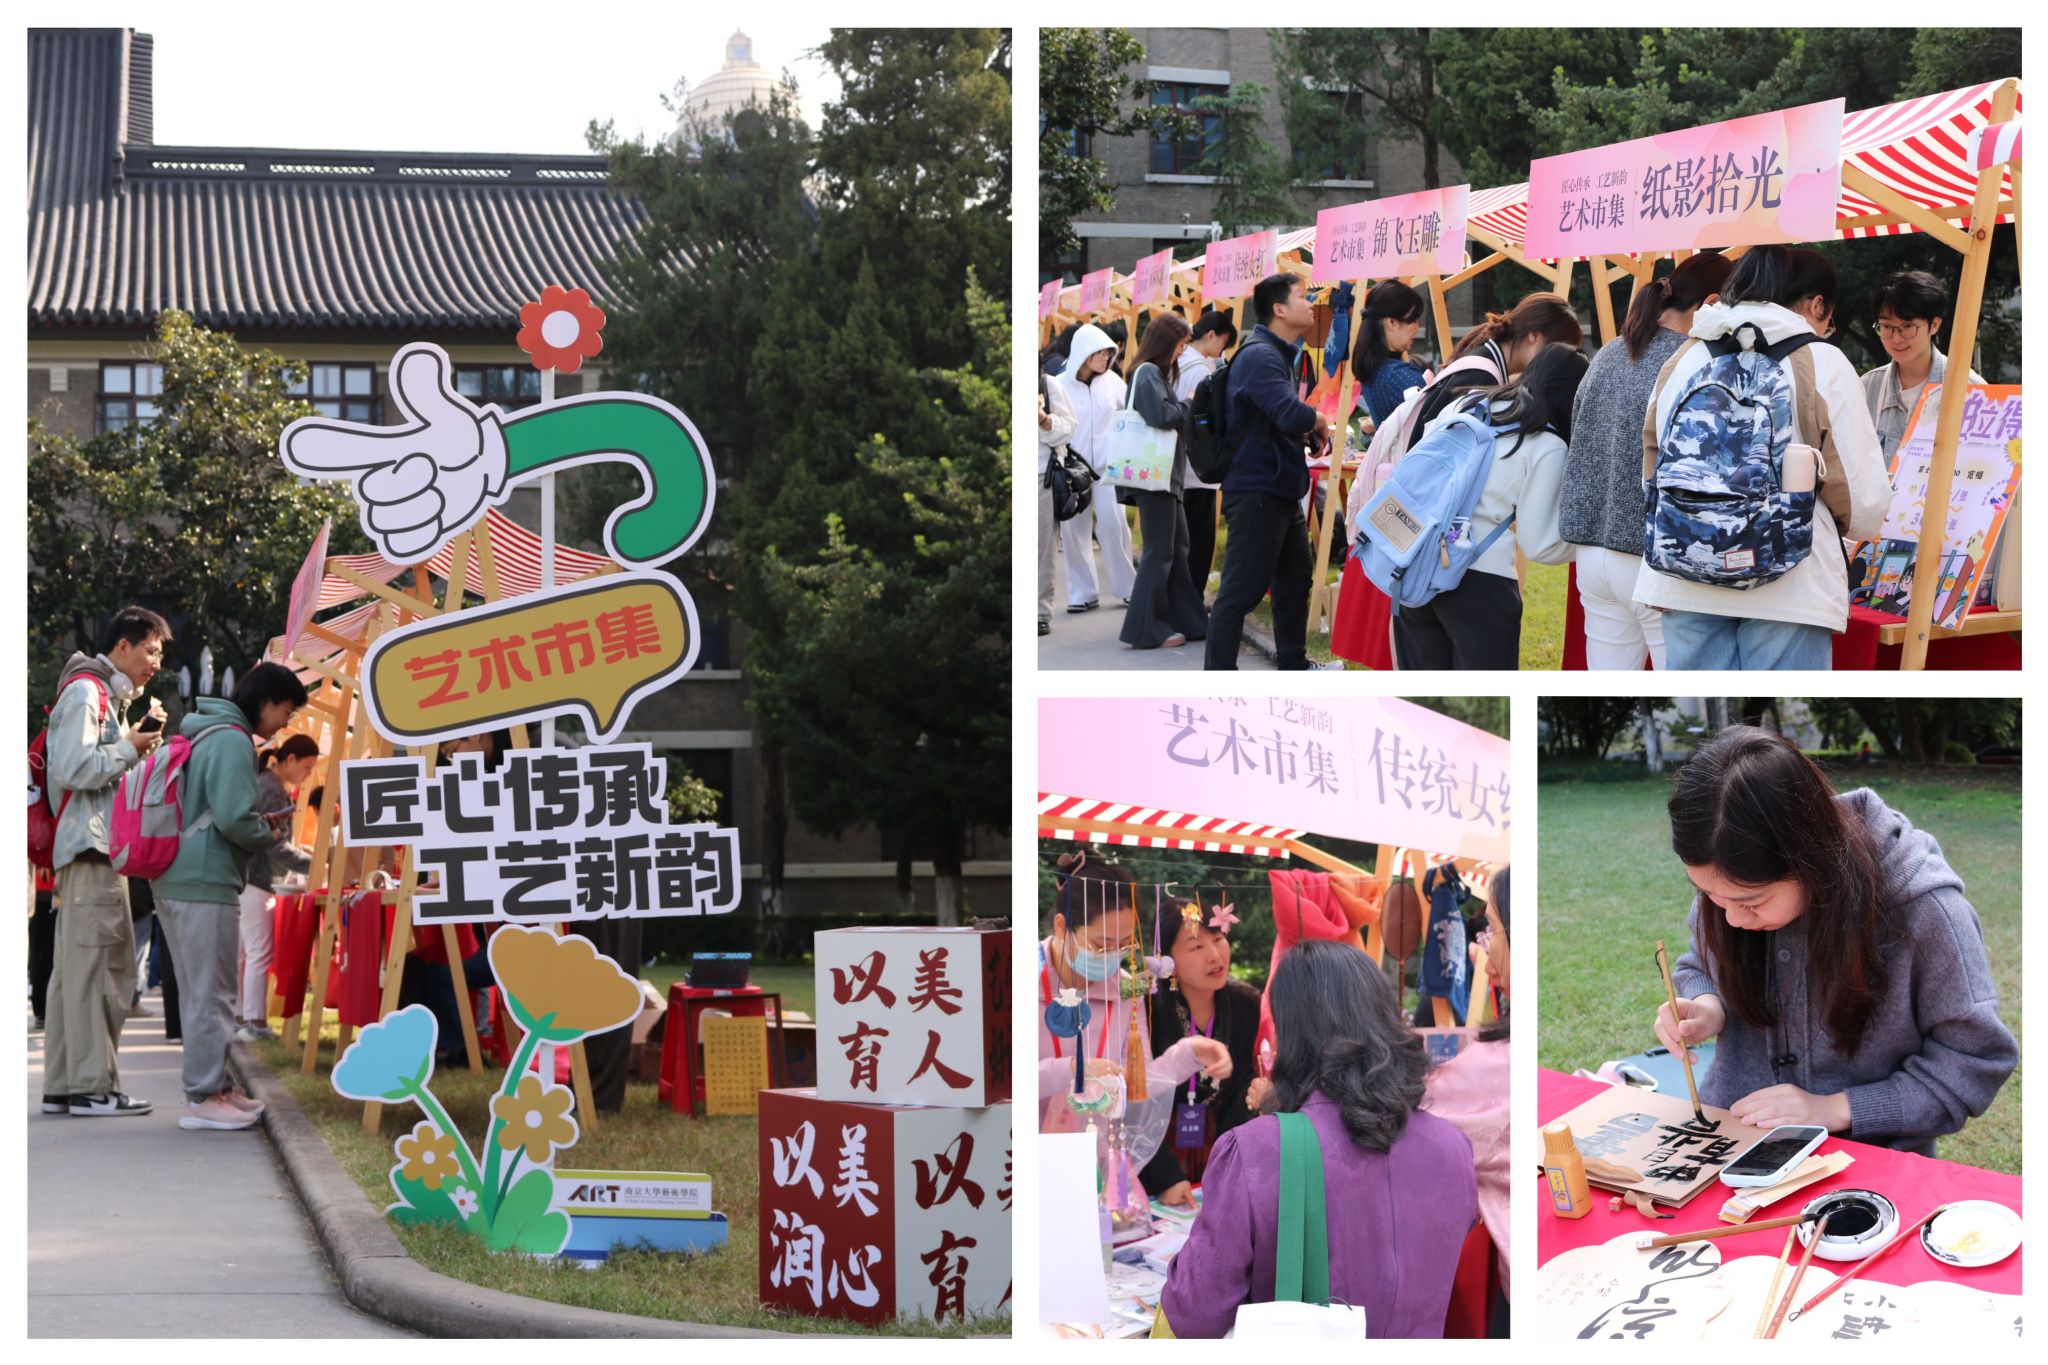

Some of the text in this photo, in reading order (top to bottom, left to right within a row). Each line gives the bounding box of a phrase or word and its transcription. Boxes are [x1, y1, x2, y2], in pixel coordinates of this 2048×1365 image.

[1559, 193, 1625, 233] 艺术市集
[1561, 169, 1628, 194] 匠心传承 工艺新韵
[1640, 146, 1783, 221] 纸影拾光
[1330, 237, 1365, 263] 艺术市集
[1373, 211, 1441, 258] 锦飞玉雕
[404, 603, 662, 709] 艺术市集
[1159, 703, 1340, 795] 艺术市集
[347, 750, 662, 839] 匠心传承
[420, 831, 732, 918] 工艺新韵
[829, 947, 963, 1015] 以美
[838, 1021, 975, 1093] 育人
[567, 1184, 621, 1203] ART
[770, 1121, 879, 1217] 以美
[770, 1209, 882, 1308] 润心
